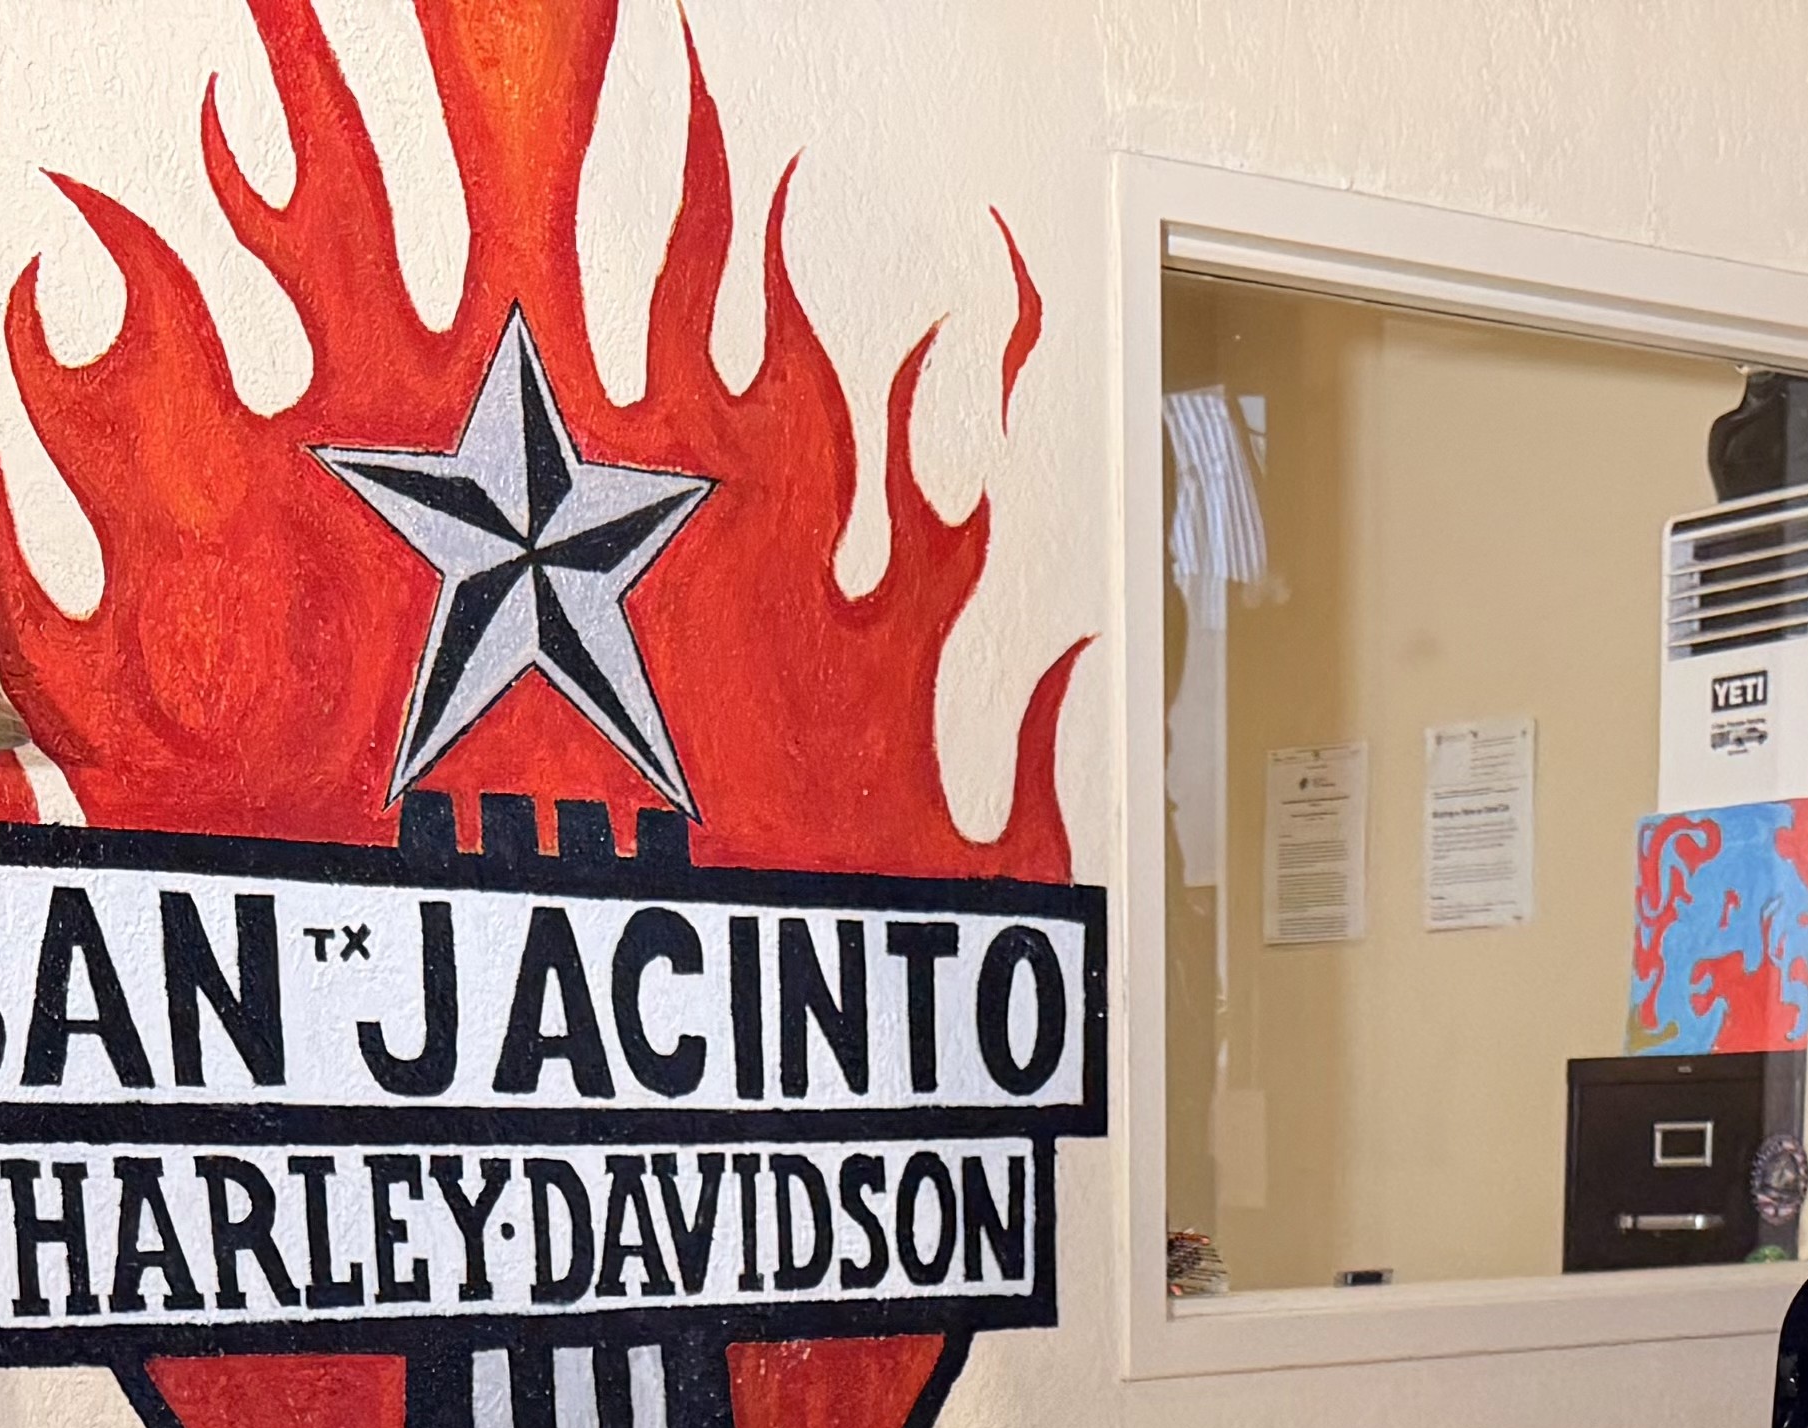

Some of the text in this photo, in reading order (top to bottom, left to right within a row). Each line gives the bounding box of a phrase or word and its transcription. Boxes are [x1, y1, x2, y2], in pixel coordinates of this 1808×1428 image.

[1714, 676, 1765, 707] YETI
[302, 922, 372, 963] TX
[355, 898, 1069, 1099] JACINTO
